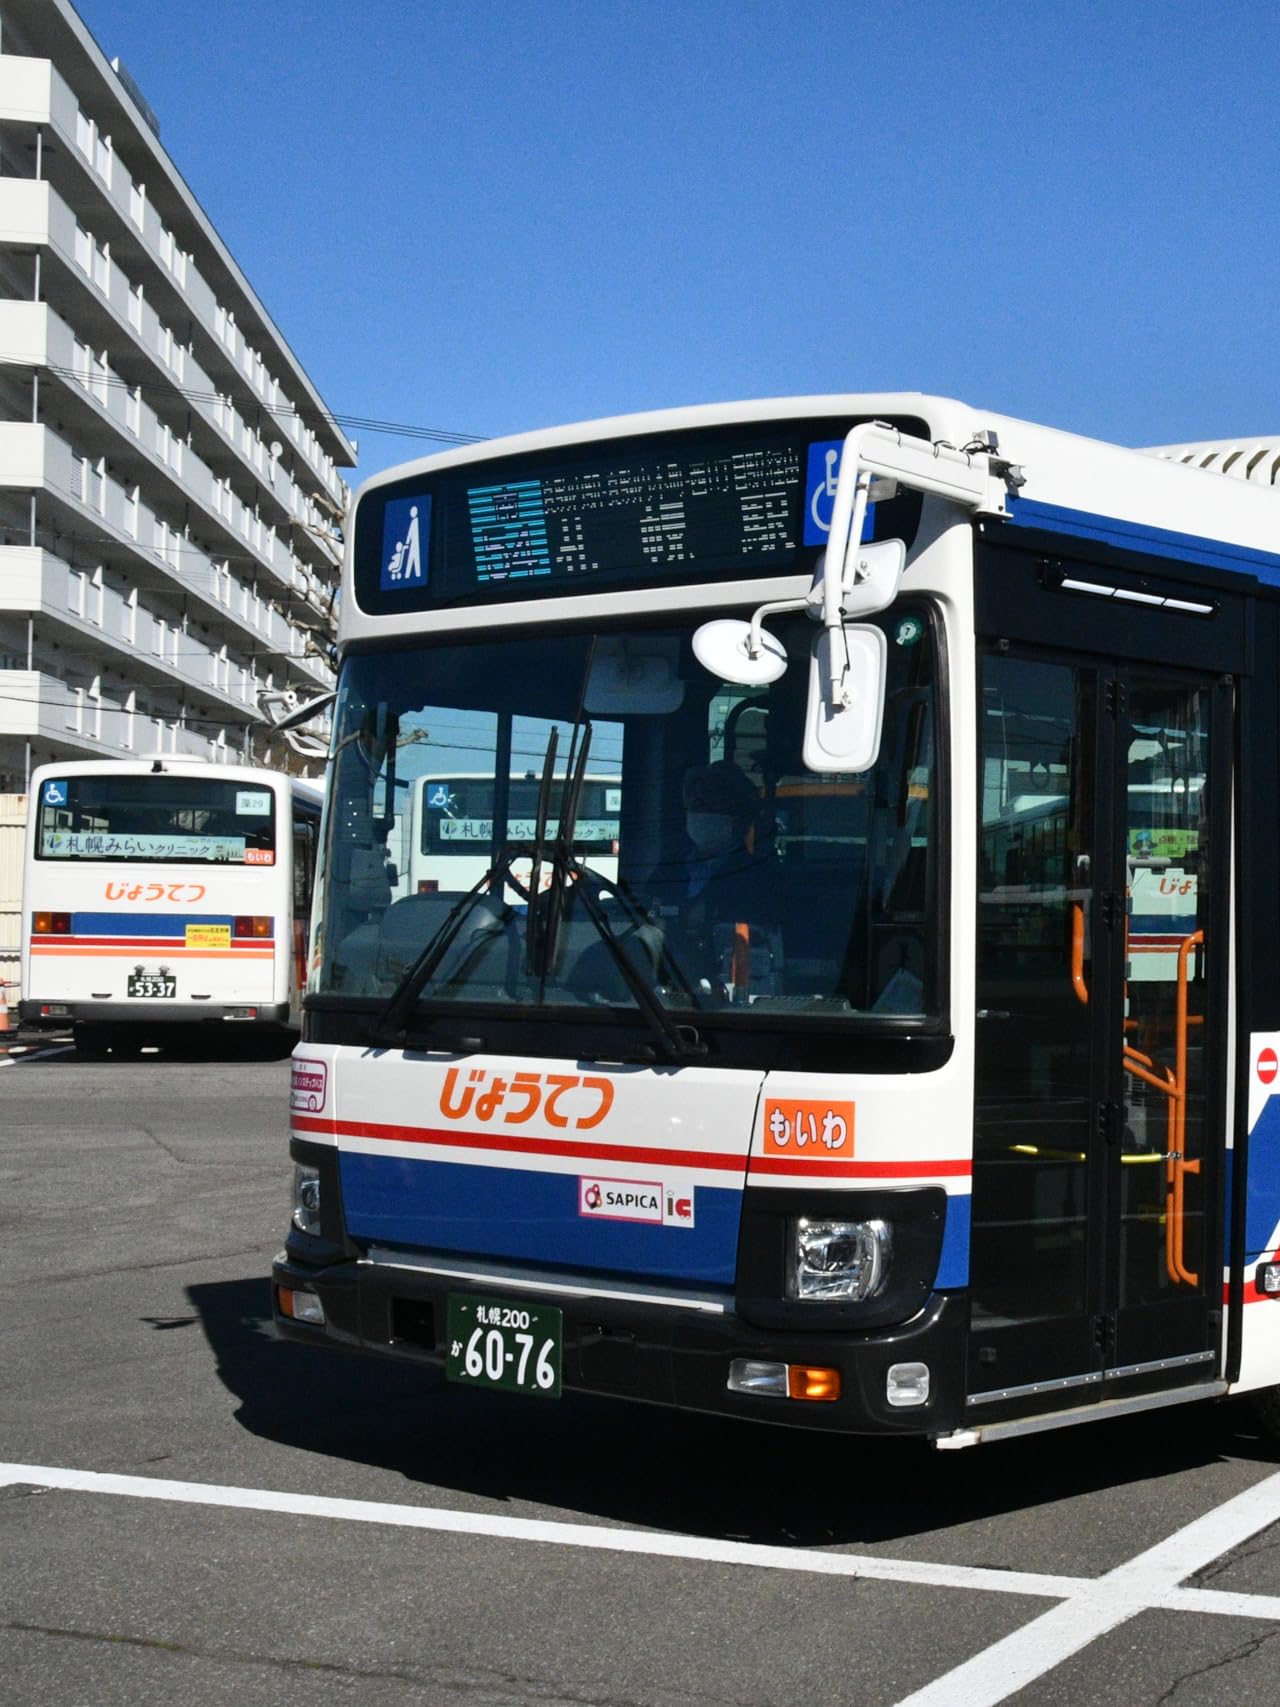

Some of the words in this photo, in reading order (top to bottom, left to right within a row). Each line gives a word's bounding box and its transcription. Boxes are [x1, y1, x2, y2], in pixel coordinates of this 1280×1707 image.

[105, 882, 206, 901] じょうてつ
[439, 1067, 615, 1130] じょうてつ
[769, 1108, 848, 1150] もいわ
[606, 1191, 659, 1210] SAPICA
[476, 1304, 531, 1330] 札幌200
[465, 1327, 556, 1389] 60-76
